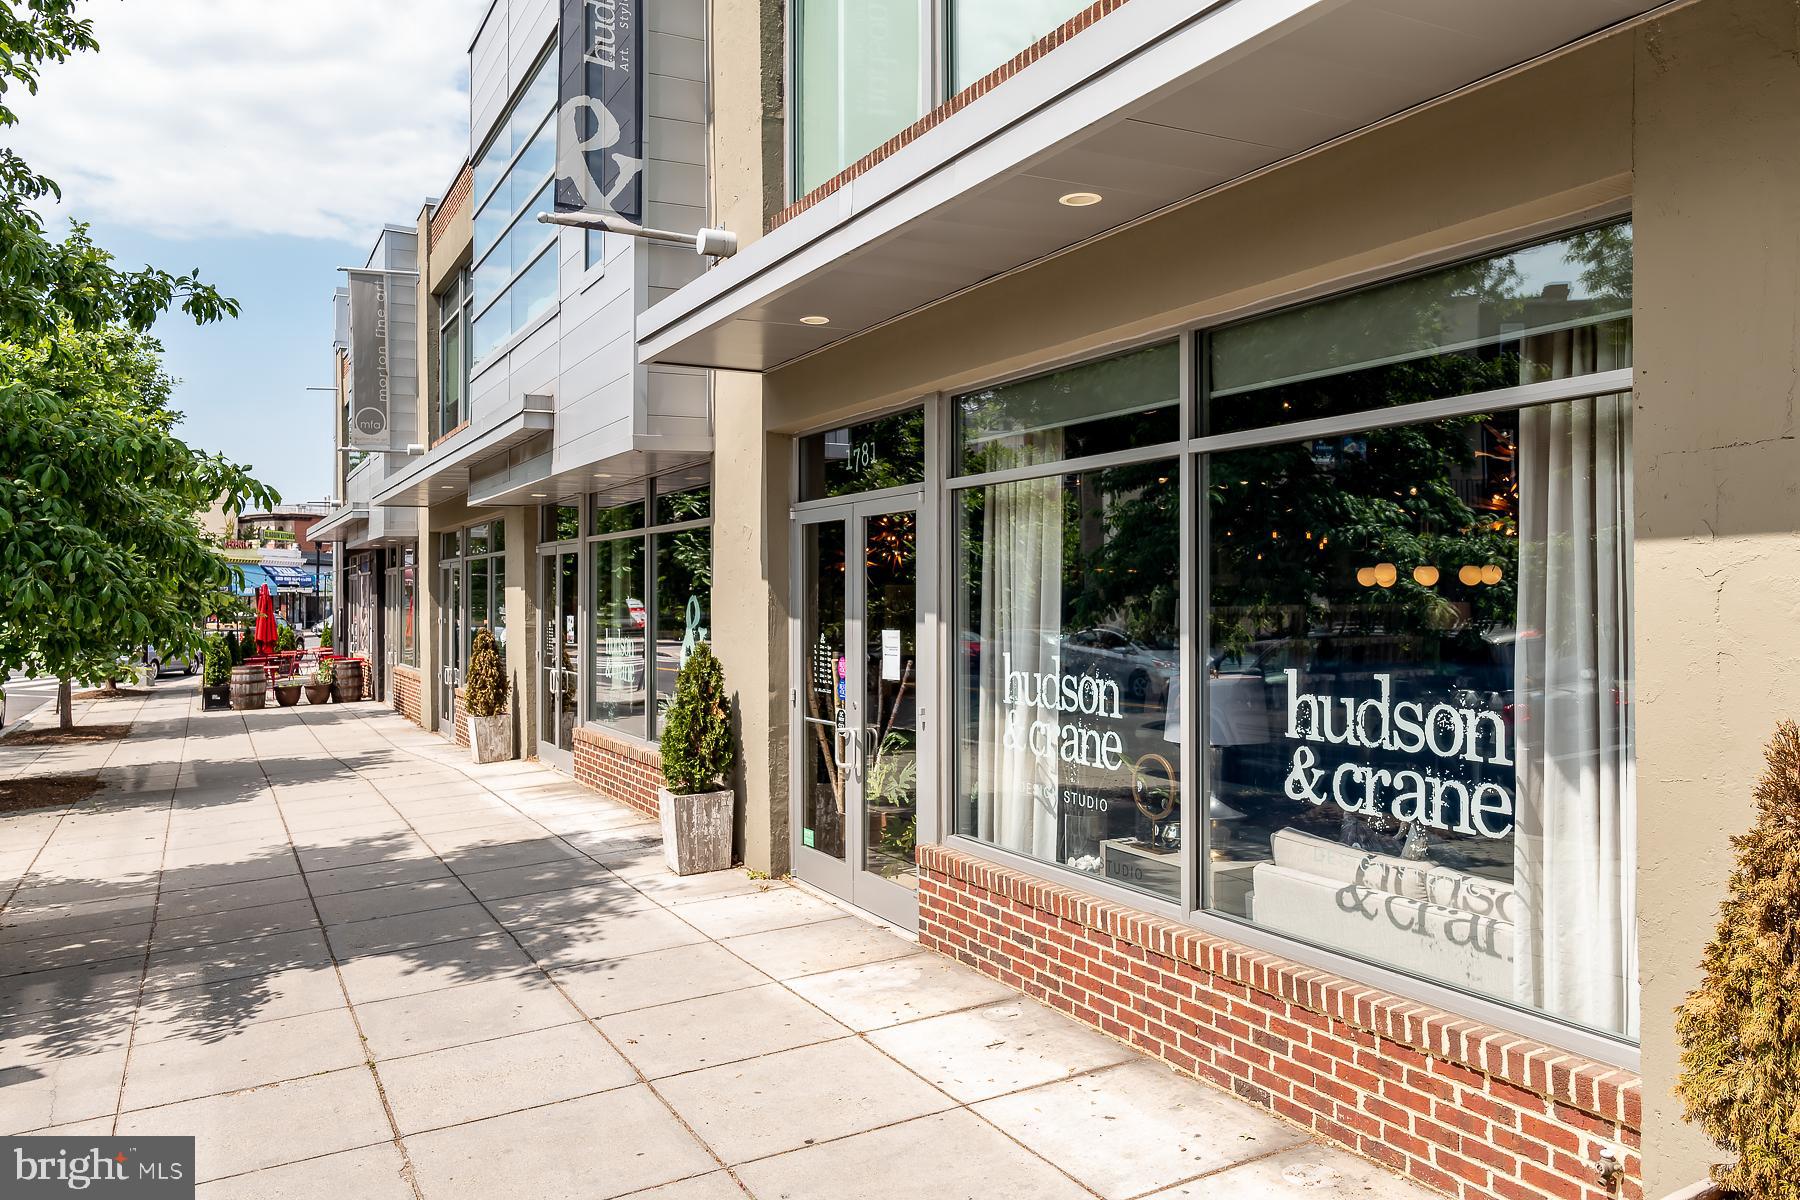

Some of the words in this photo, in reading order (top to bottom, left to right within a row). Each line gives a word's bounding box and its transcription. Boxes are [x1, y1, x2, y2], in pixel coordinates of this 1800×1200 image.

[620, 48, 629, 72] Art.
[374, 279, 385, 302] art
[376, 308, 387, 338] fine
[377, 346, 388, 402] morton
[360, 420, 382, 430] mfa
[846, 442, 878, 472] 1781
[1003, 652, 1123, 719] hudson
[1284, 668, 1514, 766] hudson
[1003, 709, 1027, 752] &
[1029, 720, 1123, 771] crane
[1063, 790, 1108, 812] STUDIO
[1284, 745, 1329, 806] &
[1333, 761, 1514, 839] crane
